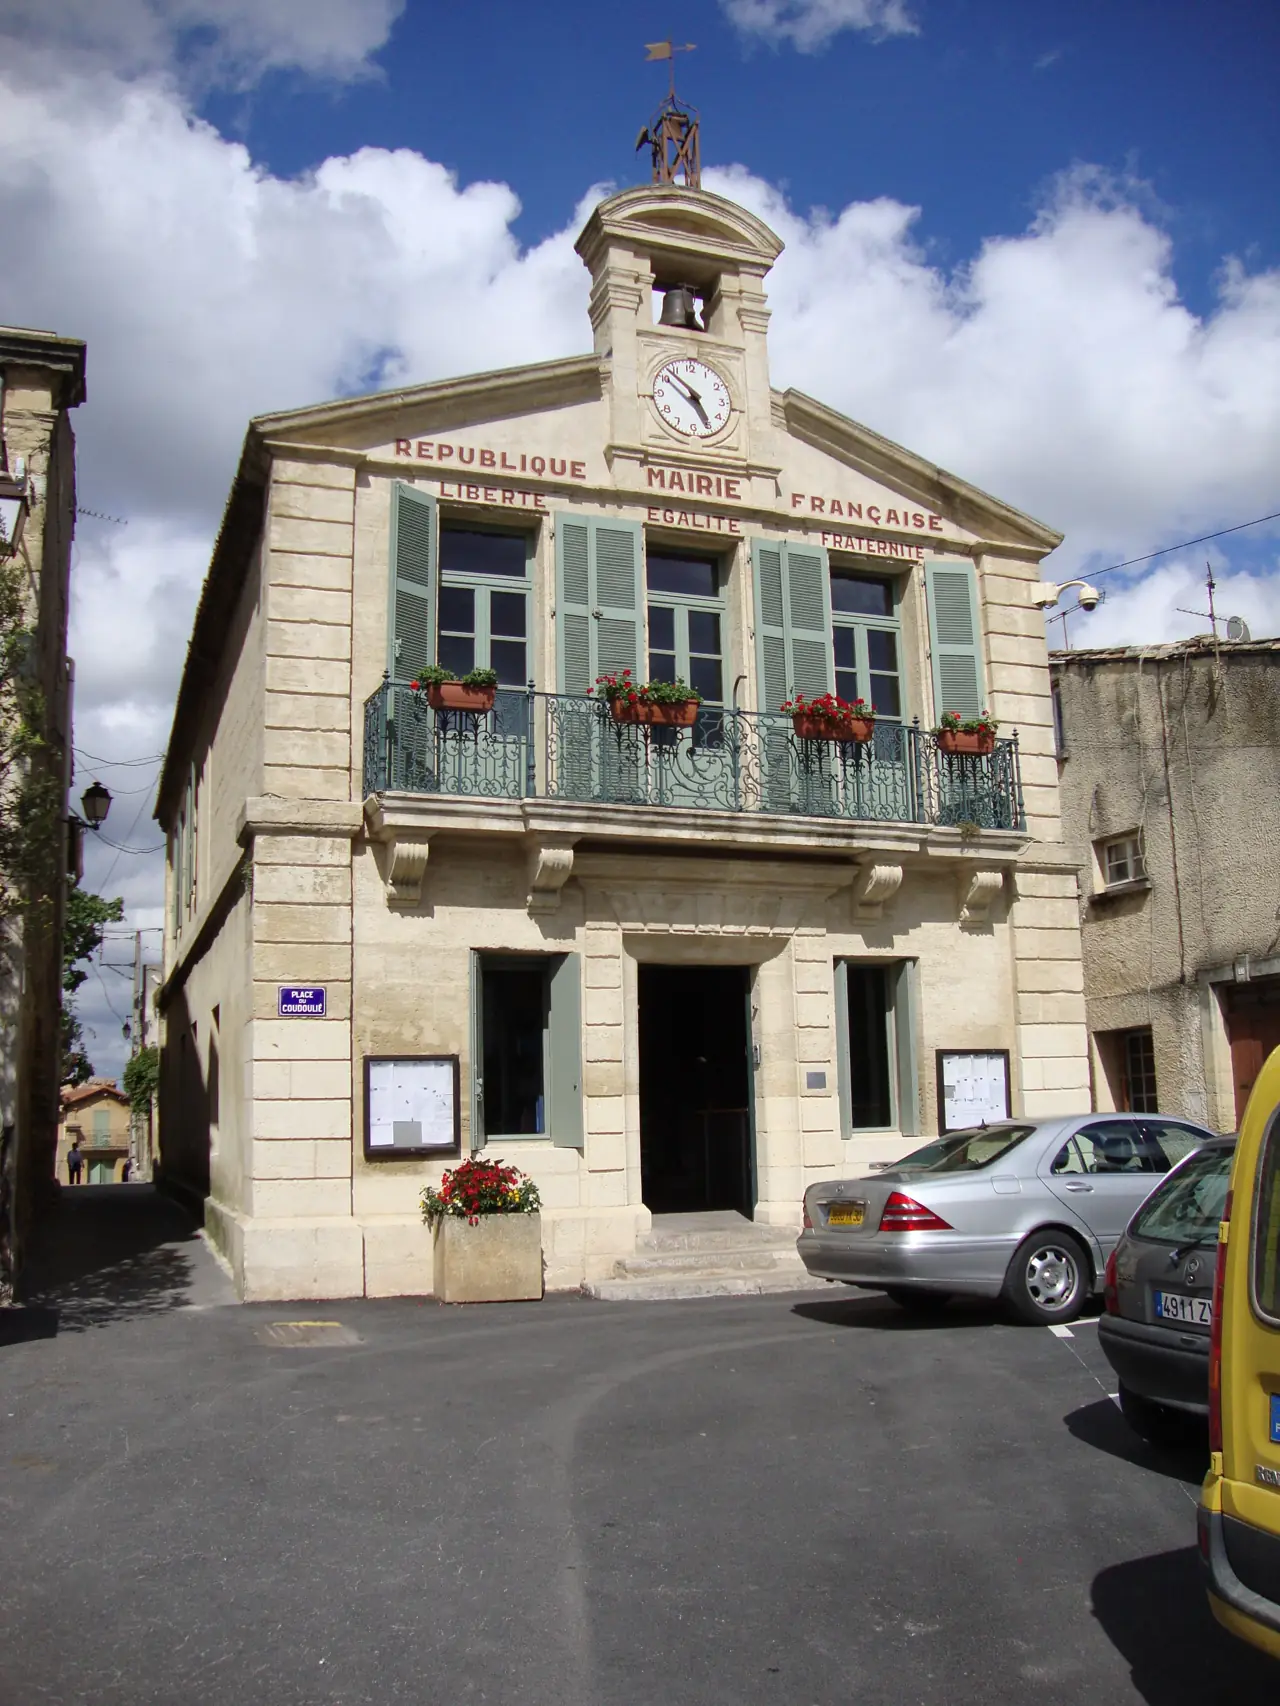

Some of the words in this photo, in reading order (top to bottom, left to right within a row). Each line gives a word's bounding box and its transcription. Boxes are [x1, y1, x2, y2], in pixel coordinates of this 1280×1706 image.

[686, 365, 696, 373] 12
[661, 374, 670, 383] 10
[713, 382, 720, 391] 2
[657, 389, 665, 397] 9
[718, 398, 725, 407] 3
[663, 405, 671, 413] 8
[674, 416, 681, 425] 7
[714, 412, 722, 421] 4
[690, 423, 697, 431] 6
[395, 438, 586, 479] REPUBLIQUE
[646, 467, 742, 500] MAIRIE
[440, 481, 546, 508] LIBERTE
[791, 492, 943, 532] FRANÇAISE
[647, 506, 741, 533] EGALITE
[820, 531, 925, 559] FRATERNITE
[1163, 1296, 1194, 1320] 4911
